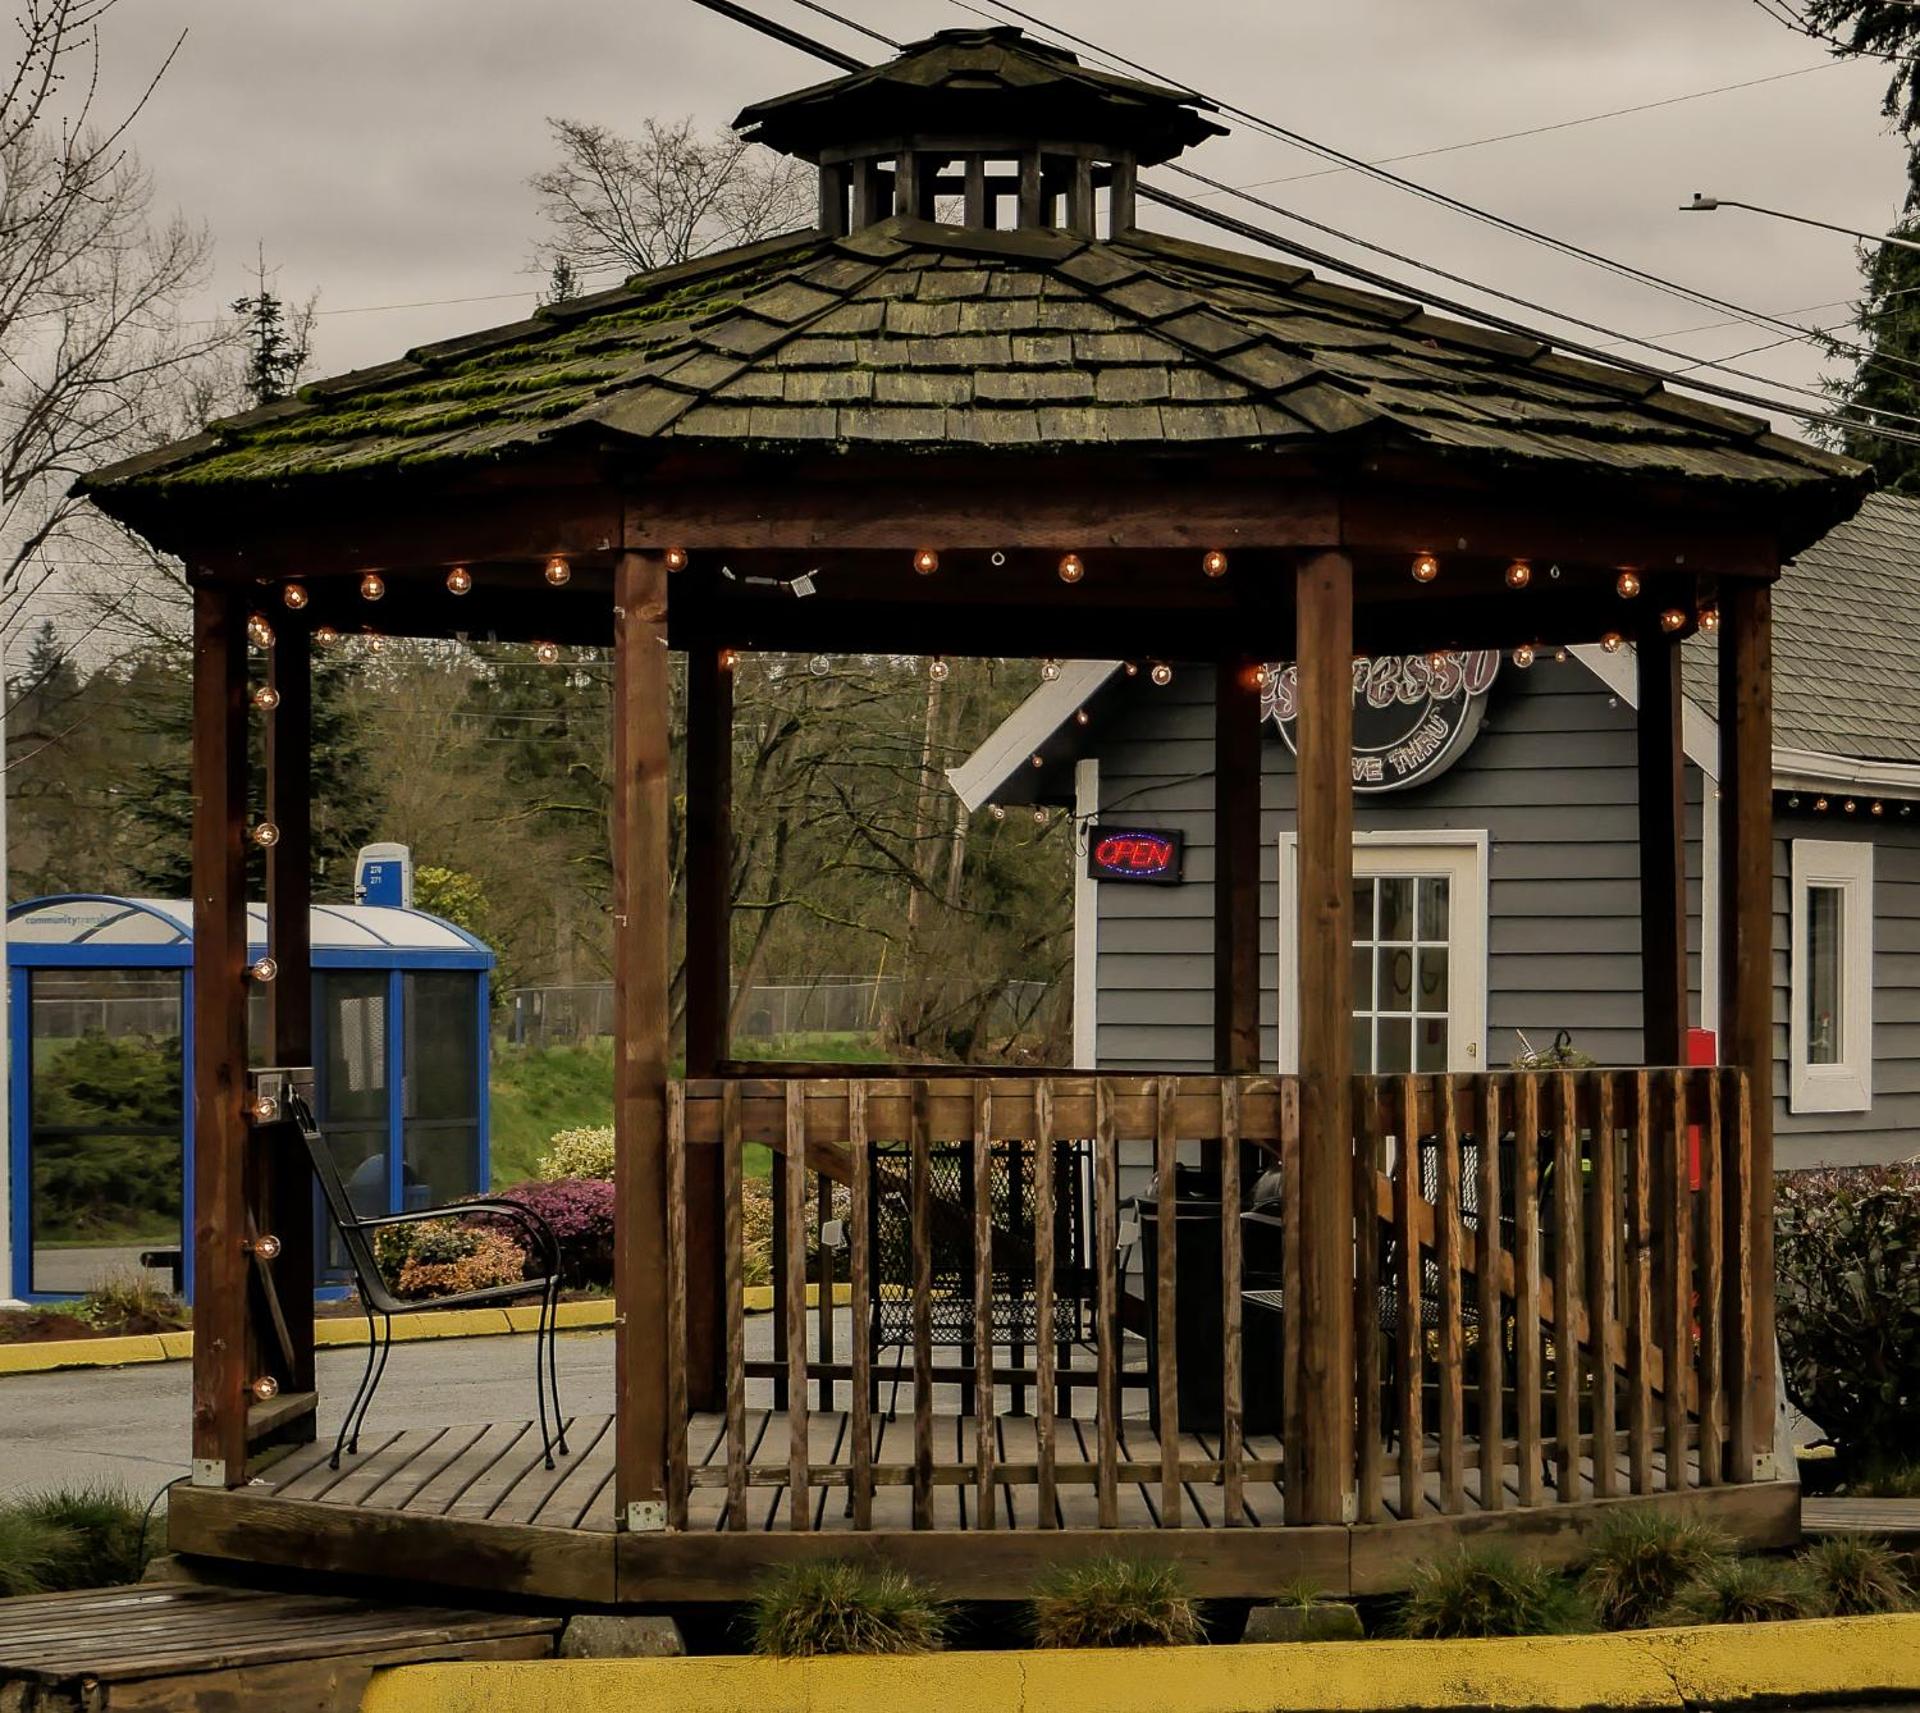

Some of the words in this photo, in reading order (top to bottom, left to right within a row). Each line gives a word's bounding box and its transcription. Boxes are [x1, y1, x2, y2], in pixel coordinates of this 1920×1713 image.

[1260, 650, 1500, 724] sresso
[1387, 704, 1450, 775] THRU
[1095, 840, 1173, 867] OPEN
